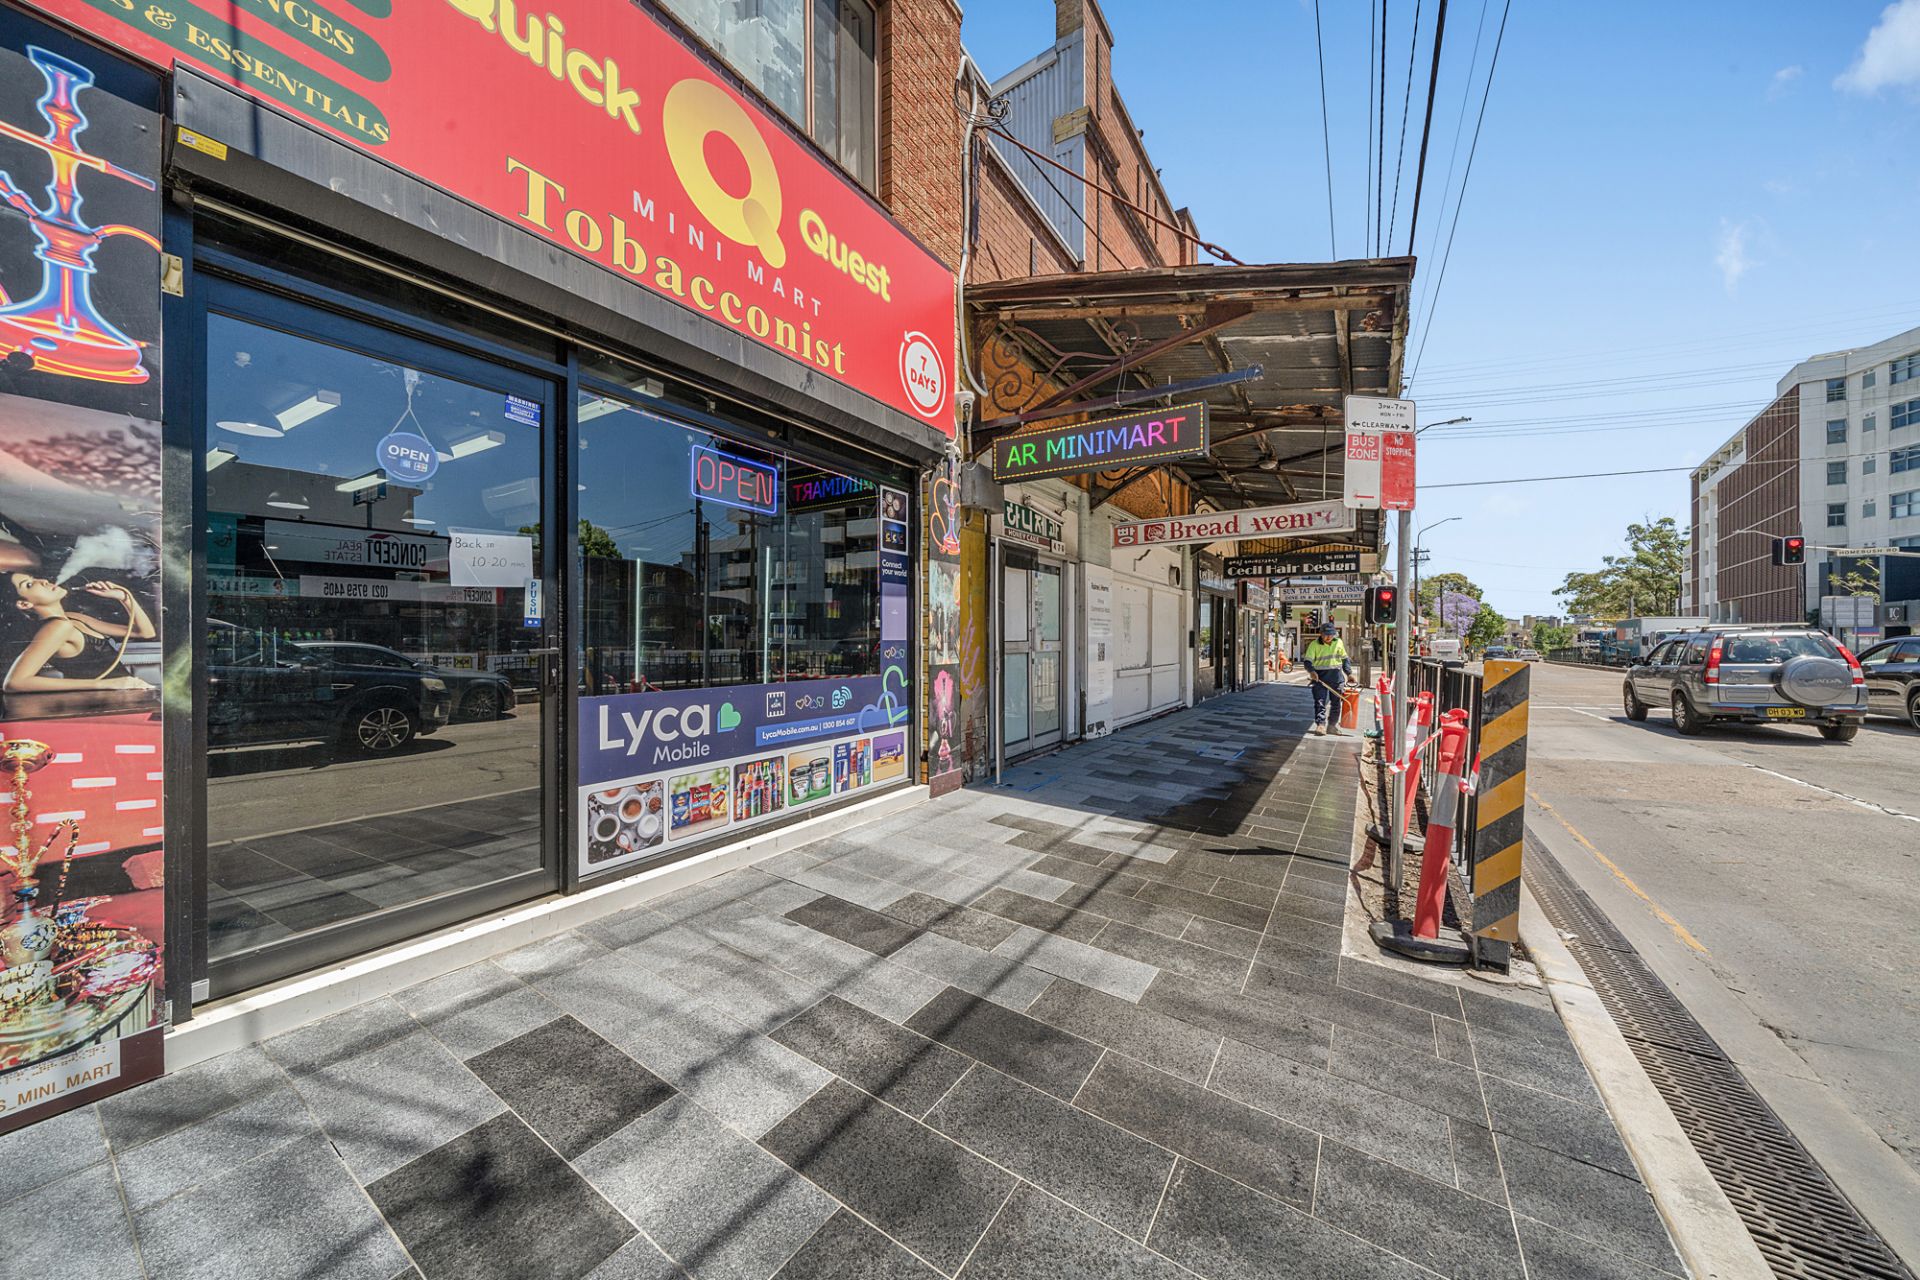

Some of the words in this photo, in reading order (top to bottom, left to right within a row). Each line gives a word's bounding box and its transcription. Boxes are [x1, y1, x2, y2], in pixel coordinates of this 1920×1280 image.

[144, 4, 177, 30] &
[185, 22, 390, 142] ESSENTIALS
[633, 190, 722, 261] MINI
[747, 260, 821, 317] MART
[799, 208, 891, 303] Quest
[506, 155, 846, 375] Tobacconist
[920, 355, 927, 371] 7
[910, 367, 936, 394] DAYS
[1362, 421, 1400, 429] CLEARWAY
[1006, 443, 1038, 469] AR
[1046, 417, 1186, 462] MINIMART
[1352, 436, 1375, 447] BUS
[1394, 437, 1404, 445] NO
[388, 444, 430, 463] OPEN
[1348, 448, 1378, 459] ZONE
[1386, 447, 1412, 456] STOPPING
[697, 456, 772, 505] OPEN
[1170, 515, 1240, 539] Bread
[1250, 509, 1333, 532] Aven
[455, 537, 482, 549] Back
[472, 556, 507, 568] 10-20
[881, 559, 902, 569] Connect
[1227, 565, 1262, 576] Cecil
[1266, 564, 1300, 574] Hair
[1303, 562, 1356, 573] Design
[881, 568, 894, 576] your
[894, 569, 908, 577] world
[1337, 585, 1365, 593] CUISINE
[529, 581, 537, 616] PUSH
[832, 689, 845, 708] 5G
[599, 704, 711, 756] Lyca
[762, 725, 818, 741] LycaMobile.com.au
[652, 741, 710, 765] Mobile
